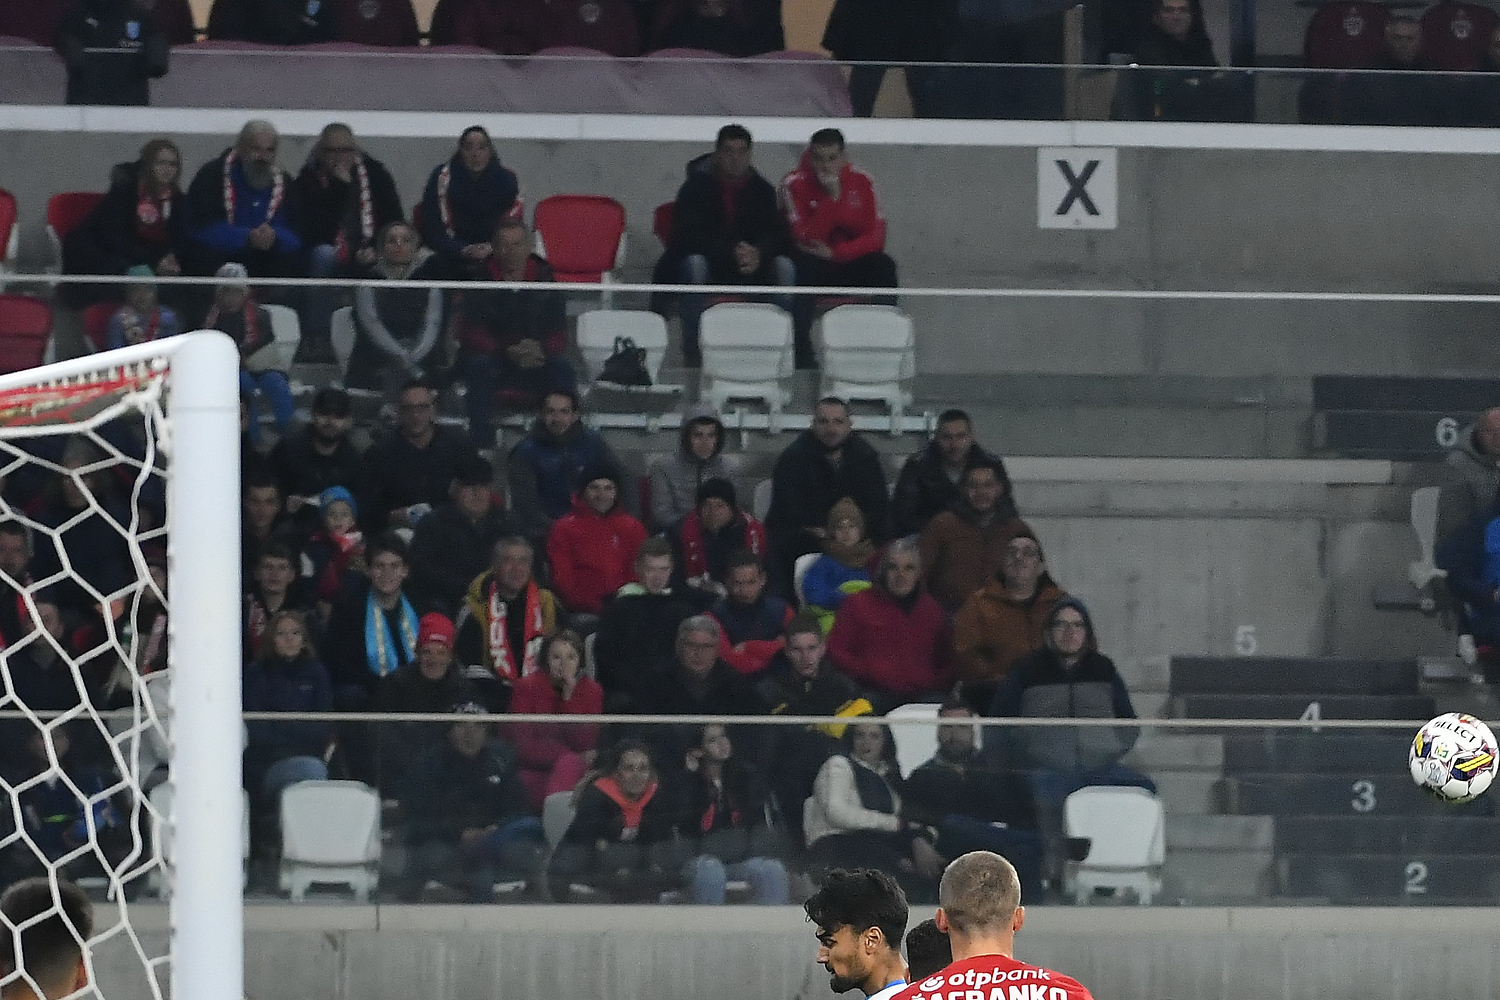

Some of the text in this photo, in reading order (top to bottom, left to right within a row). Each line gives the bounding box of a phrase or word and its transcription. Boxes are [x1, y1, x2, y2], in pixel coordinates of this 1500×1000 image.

[1054, 159, 1100, 215] X
[1436, 417, 1459, 446] 6
[1234, 625, 1257, 656] 5
[1300, 701, 1322, 733] 4
[1433, 721, 1477, 743] SELECT
[1351, 779, 1377, 813] 3
[1405, 861, 1428, 894] 2
[949, 967, 1051, 990] otpbank
